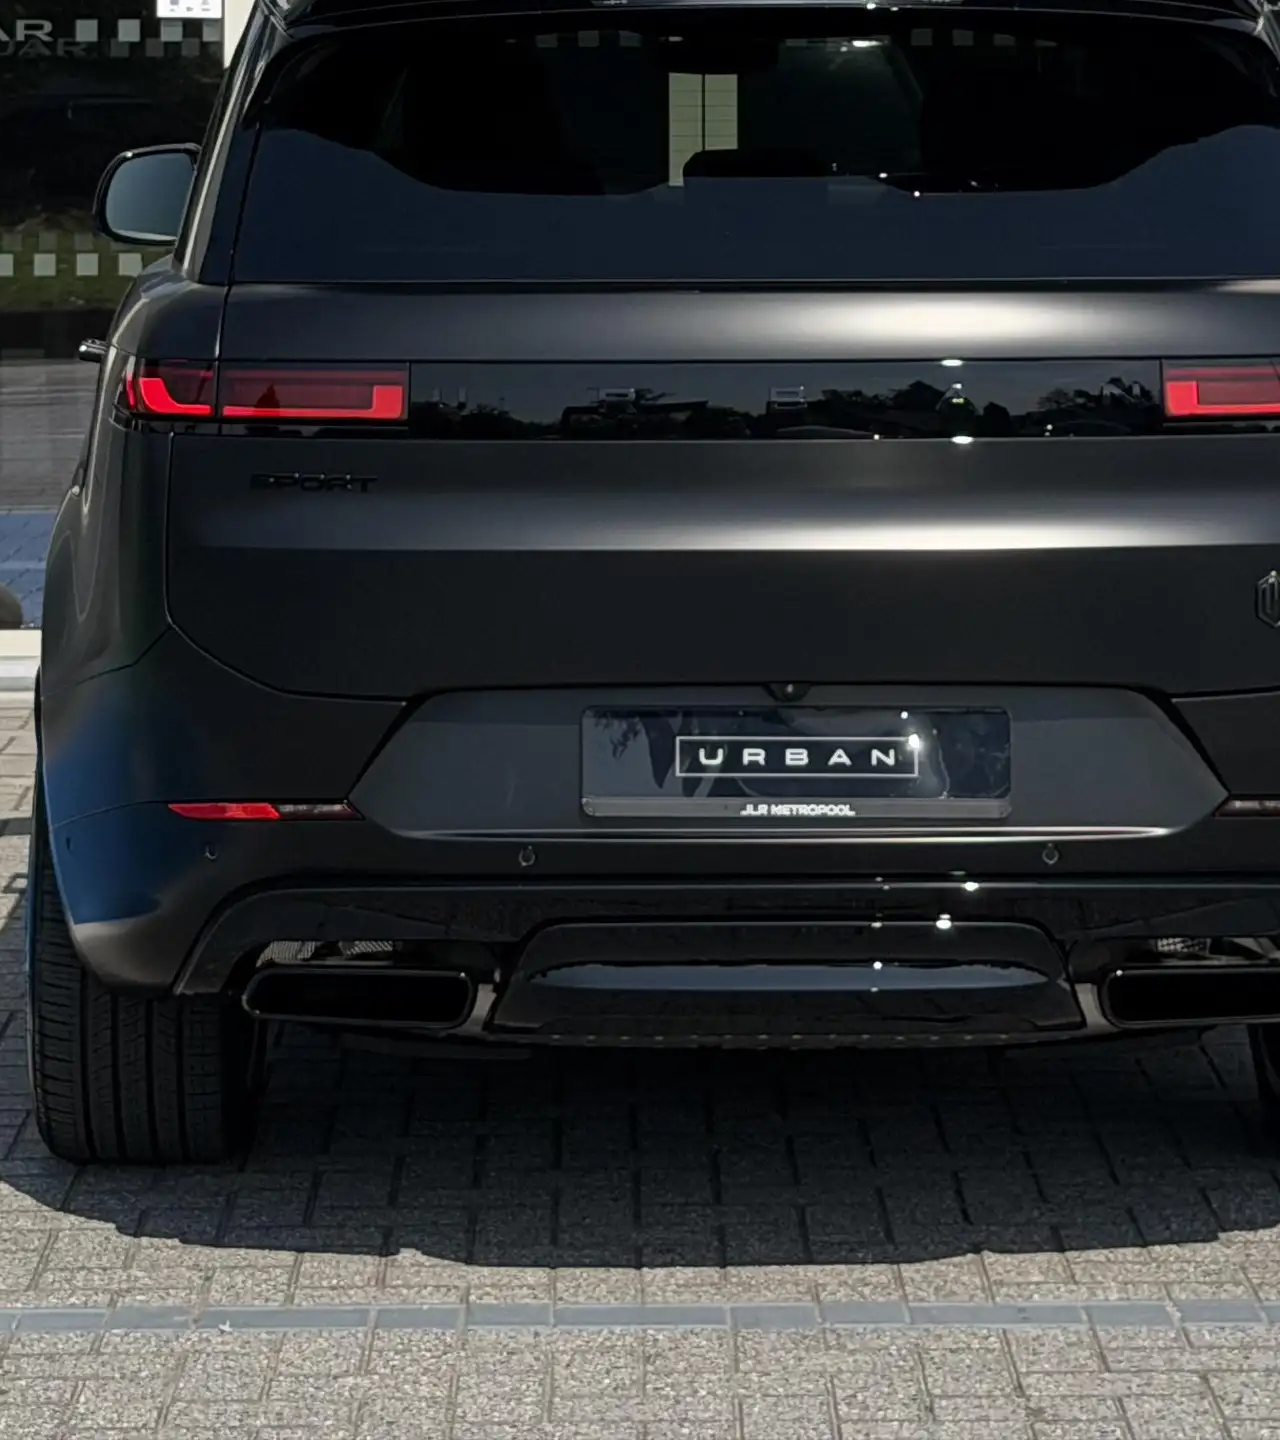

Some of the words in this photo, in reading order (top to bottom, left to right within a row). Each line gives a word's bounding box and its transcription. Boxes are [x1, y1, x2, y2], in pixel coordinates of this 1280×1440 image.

[698, 747, 896, 766] URBAN
[740, 803, 768, 816] JLR
[770, 803, 856, 816] METROPOOL
